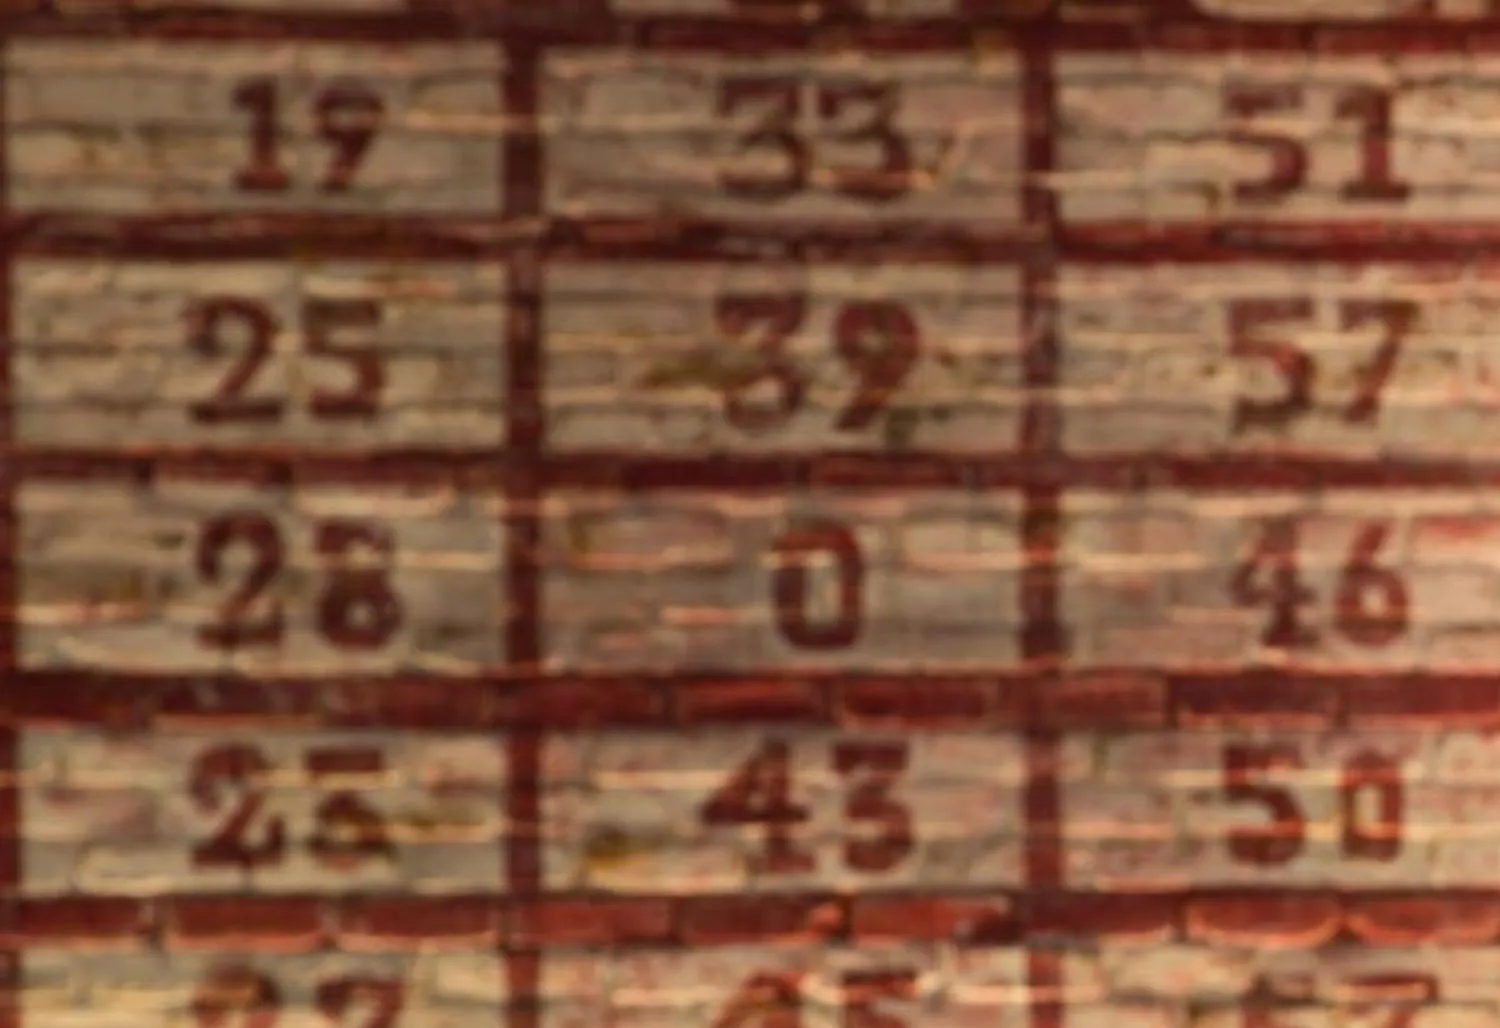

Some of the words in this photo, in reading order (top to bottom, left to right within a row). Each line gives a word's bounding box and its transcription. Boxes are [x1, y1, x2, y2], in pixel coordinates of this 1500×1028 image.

[231, 76, 386, 194] 19
[714, 78, 914, 199] 33
[1218, 81, 1409, 204] 51
[187, 294, 387, 423] 25
[713, 293, 920, 432] 39
[1225, 296, 1418, 434] 57
[199, 511, 403, 649] 28
[772, 521, 866, 652] 0
[1231, 519, 1410, 650] 46
[703, 737, 916, 874] 43
[1221, 738, 1402, 867] 50
